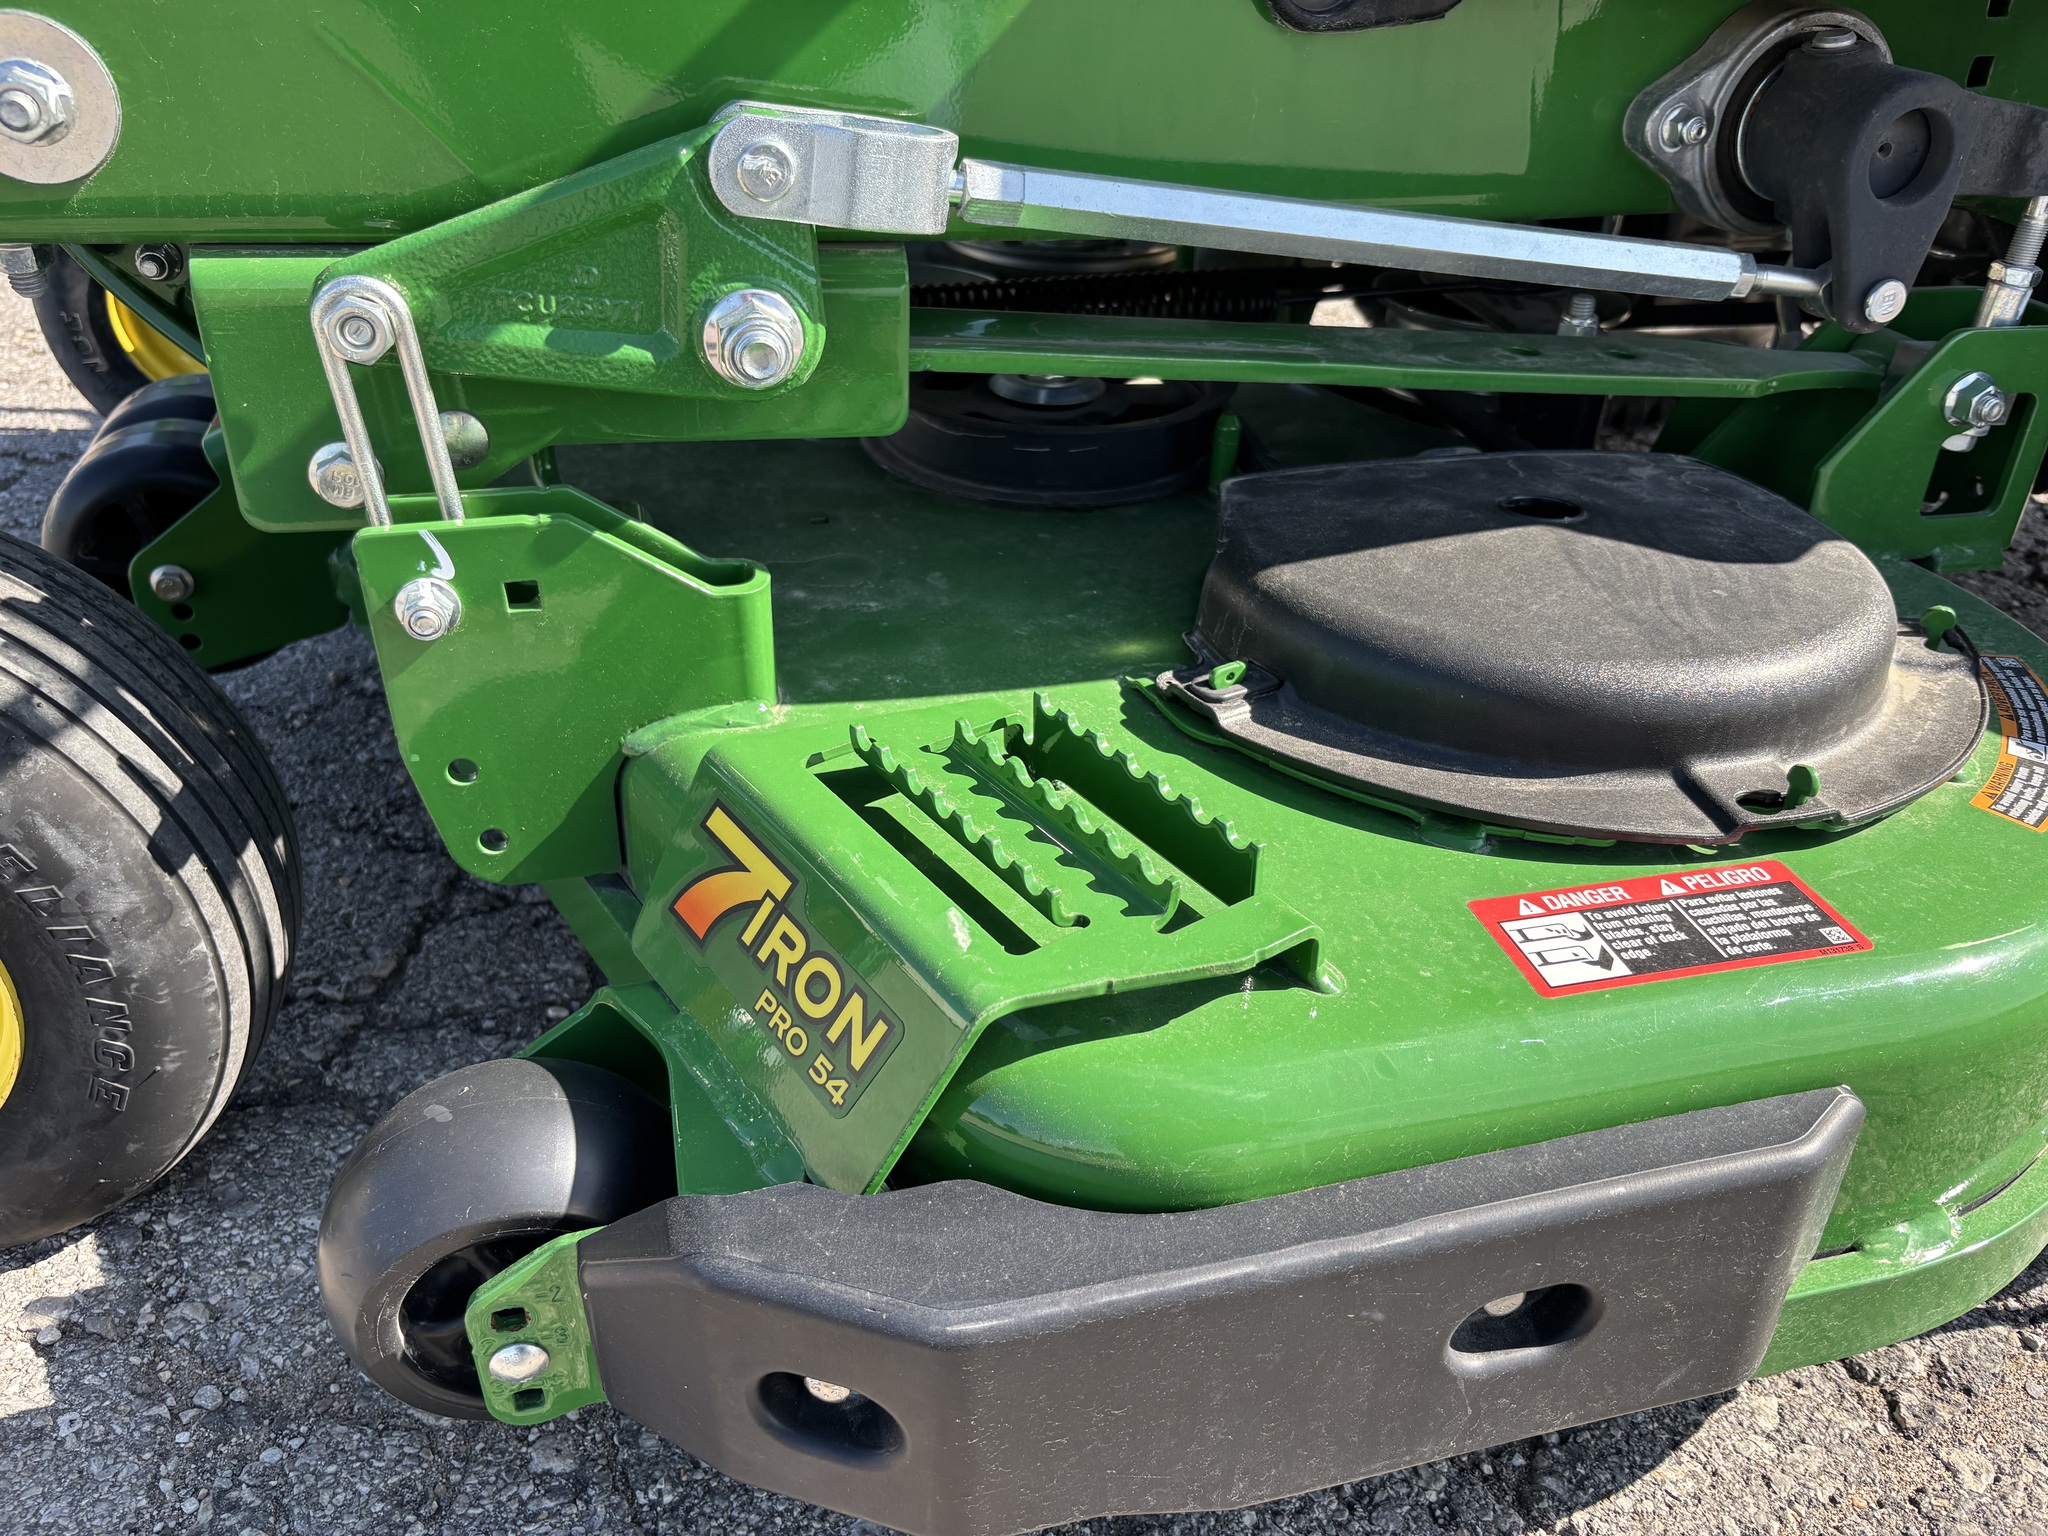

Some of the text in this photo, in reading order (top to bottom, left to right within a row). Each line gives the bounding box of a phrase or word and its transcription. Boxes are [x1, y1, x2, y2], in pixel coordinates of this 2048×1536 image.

[1981, 671, 2012, 713] ADVERTENCIA
[1985, 761, 2014, 792] WARNING
[1680, 867, 1771, 890] PELIGRO
[1541, 886, 1632, 910] DANGER
[1677, 887, 1783, 907] Para evitar lesiones
[1688, 898, 1778, 916] causadas por las
[1584, 911, 1603, 921] To
[1603, 906, 1637, 919] avoid
[1593, 912, 1673, 931] from rotating
[1697, 903, 1814, 926] cuchillas, mantenerse
[1601, 922, 1676, 941] blades, stay
[1706, 912, 1821, 936] alejado del borde de
[669, 799, 891, 1075] 7 IRON
[1611, 931, 1690, 950] clear of deck
[1714, 928, 1793, 945] la plataforma
[1620, 947, 1657, 960] edge.
[1725, 941, 1778, 955] de corte.
[752, 987, 851, 1106] PRO 54
